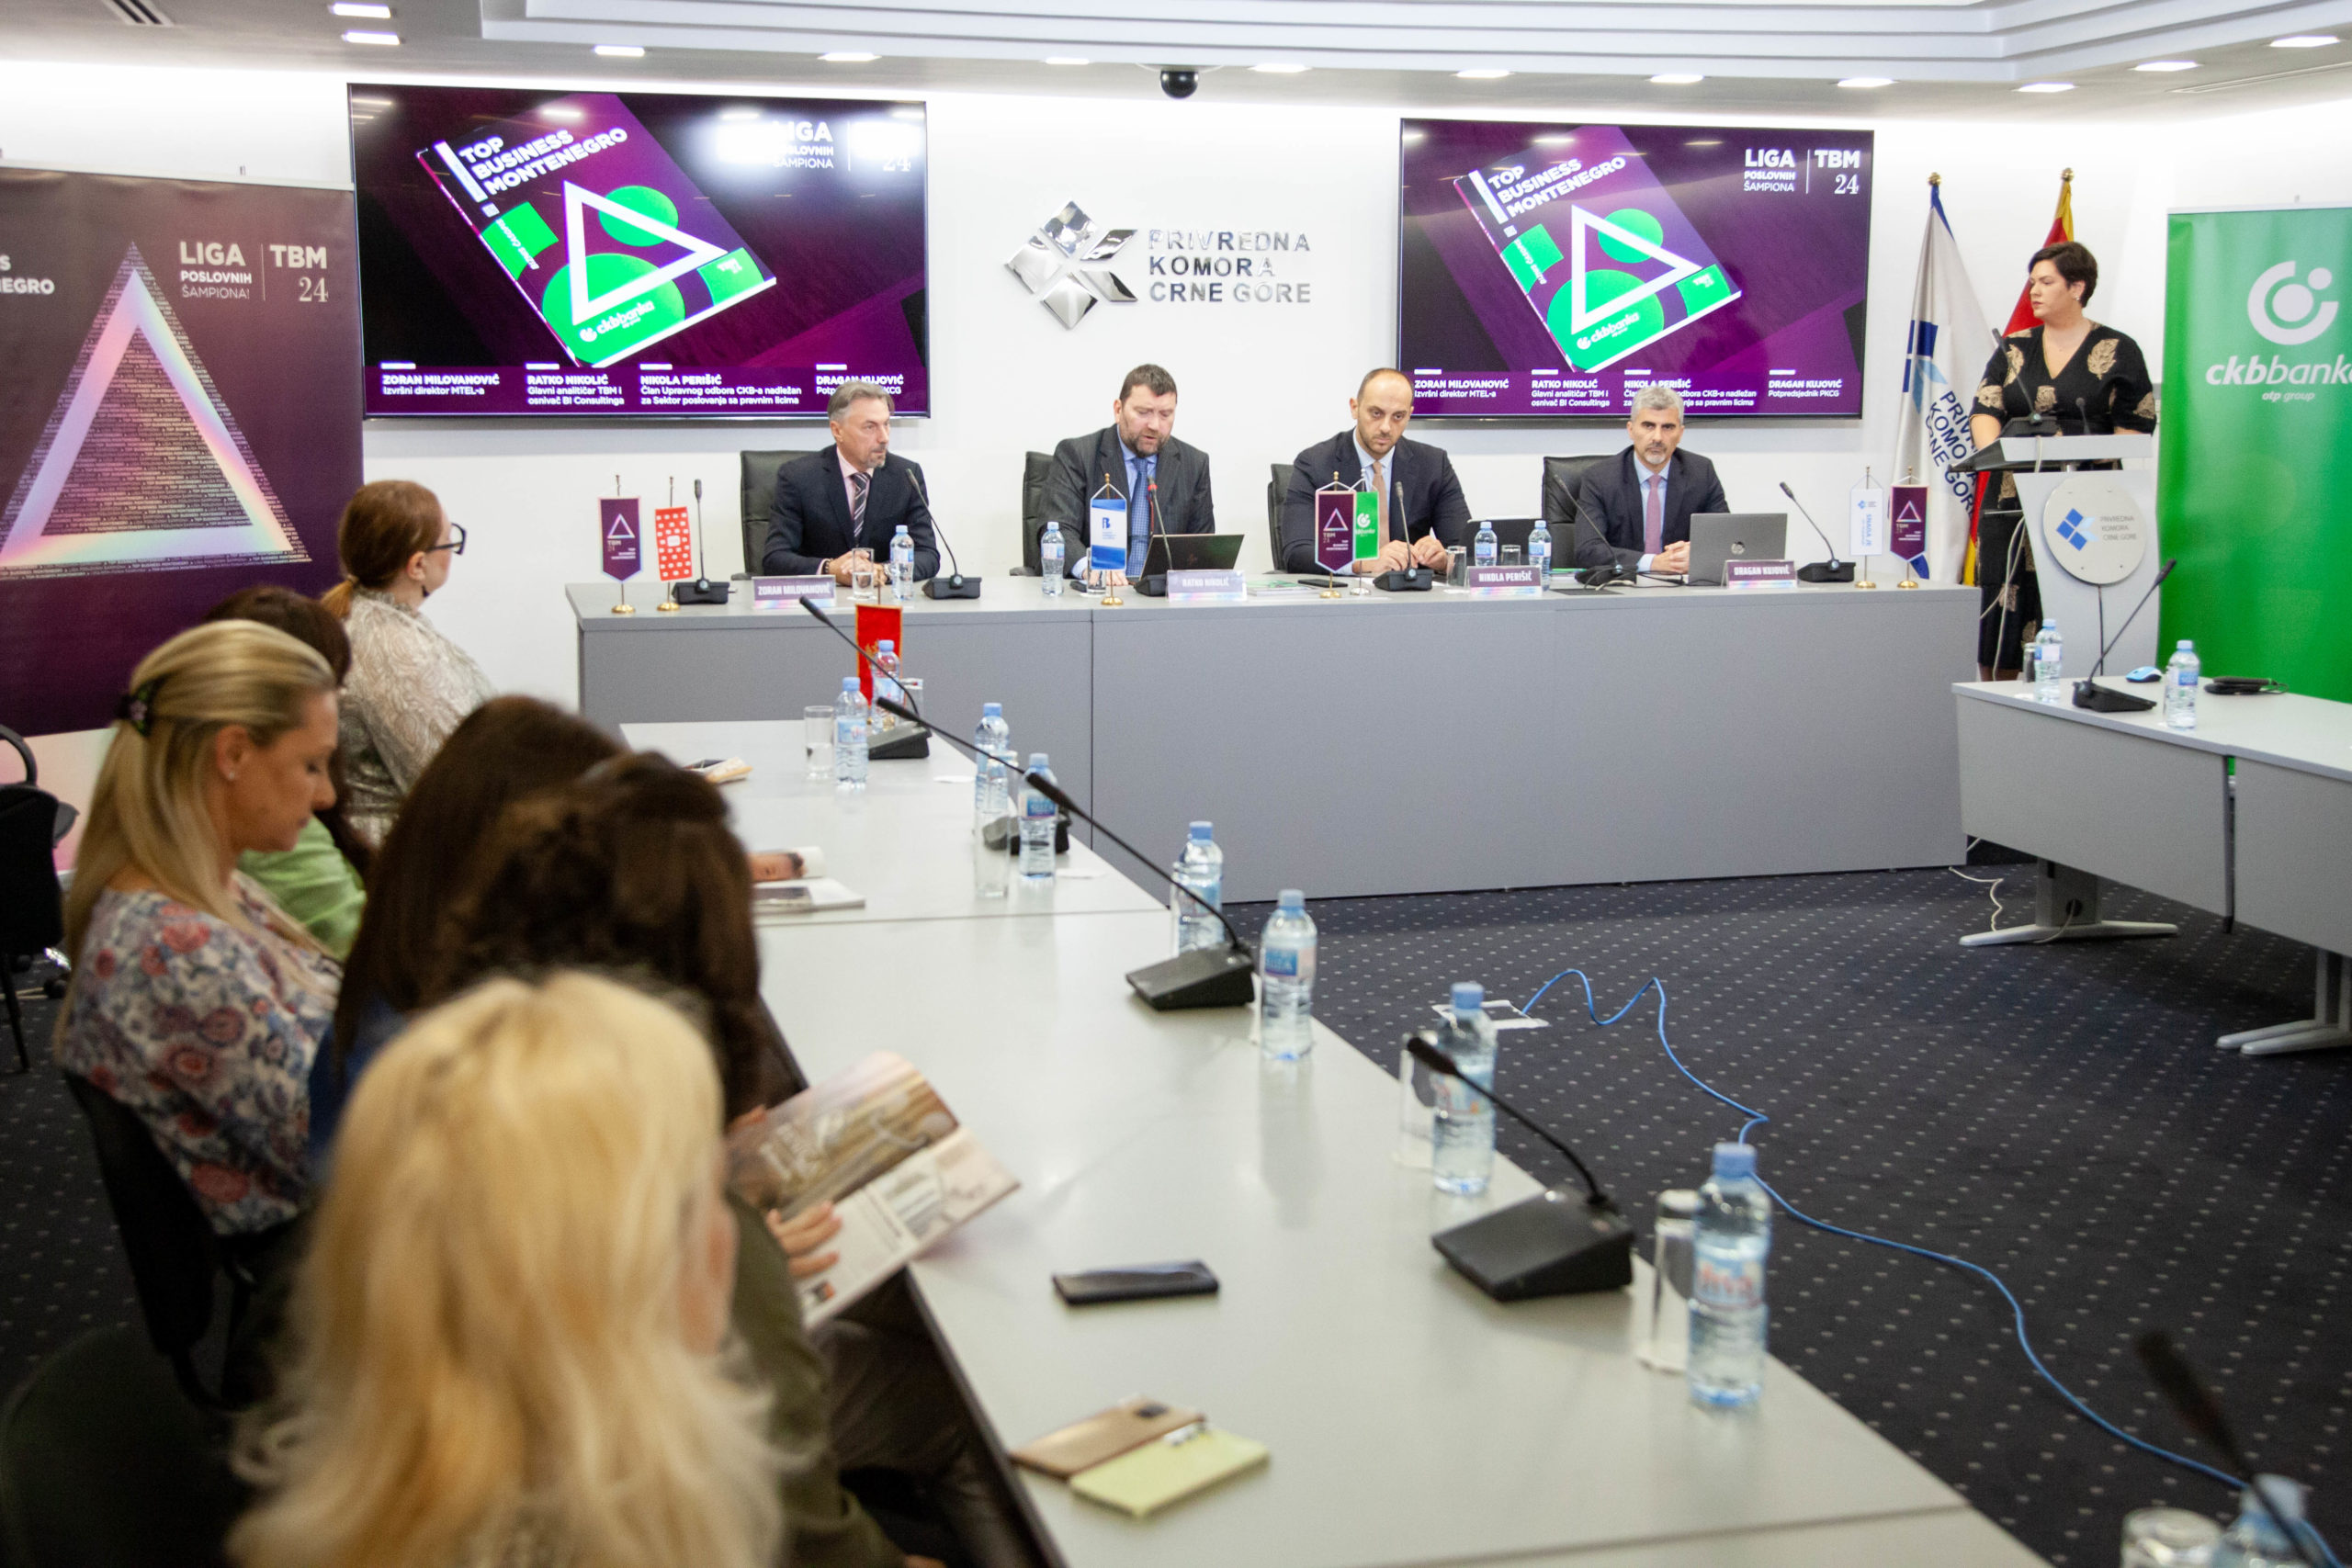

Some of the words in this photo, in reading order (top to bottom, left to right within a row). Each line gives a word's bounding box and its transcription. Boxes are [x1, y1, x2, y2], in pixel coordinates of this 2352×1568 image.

[772, 120, 833, 141] IGA
[458, 136, 504, 164] TOP
[471, 130, 574, 180] BUSINESS
[483, 128, 628, 196] MONTENEGRO
[1745, 149, 1796, 167] LIGA
[1815, 150, 1860, 169] TBM
[1487, 164, 1525, 189] TOP
[1497, 158, 1582, 204] BUSINESS
[1744, 171, 1796, 180] POSLOVNIH
[1506, 156, 1626, 218] MONTENEGRO
[1744, 180, 1794, 192] ŠAMPIONA
[1834, 174, 1860, 195] 24
[1148, 230, 1311, 252] PRIVREDNA
[180, 241, 246, 266] LIGA
[269, 243, 328, 269] TBM
[1148, 255, 1275, 276] KOMORA
[181, 270, 253, 284] POSLOVNIH
[0, 277, 55, 295] EGRO
[299, 276, 329, 302] 24
[1148, 282, 1223, 302] CRNE
[1233, 282, 1311, 303] GORE
[2206, 354, 2352, 386] ckbbank
[382, 375, 423, 385] ZORAN
[424, 374, 500, 385] MILOVANOVIĆ
[527, 375, 564, 385] RATKO
[565, 374, 608, 385] NIKOLIĆ
[640, 375, 681, 385] NIKOLA
[683, 374, 722, 385] PERIŠIĆ
[816, 376, 859, 385] DRAGAN
[1414, 379, 1446, 389] ZORAN
[1448, 378, 1510, 389] MILOVANOVIĆ
[1532, 379, 1561, 389] RATKO
[1563, 378, 1598, 389] NIKOLIĆ
[1624, 380, 1657, 389] NIKOLA
[1657, 378, 1691, 389] PERIŠIĆ
[1769, 380, 1804, 389] DRAGAN
[1806, 378, 1843, 389] KUJOVIĆ
[383, 386, 413, 395] Izvršni
[414, 386, 450, 395] direktor
[451, 387, 485, 395] MTEL-a
[527, 386, 555, 395] Glavni
[598, 386, 616, 395] TBM
[641, 386, 661, 395] Član
[662, 386, 702, 397] Upravnog
[705, 386, 735, 395] odbora
[736, 386, 763, 396] CKB-a
[881, 386, 902, 395] KCG
[1414, 389, 1439, 398] Izvršni
[1440, 389, 1468, 398] direktor
[1469, 389, 1497, 398] MTEL-a
[1532, 389, 1554, 398] Glavni
[1623, 389, 1638, 398] Čla
[1702, 389, 1724, 398] CKB-a
[1769, 389, 1819, 399] Potpredsjednik
[2262, 390, 2281, 402] otp
[2283, 391, 2315, 402] group
[527, 395, 561, 405] osnivač
[573, 396, 625, 406] Consultinga
[653, 397, 681, 405] Sektor
[683, 397, 728, 407] poslovanja
[740, 397, 774, 407] pravnim
[775, 397, 799, 405] licima
[1532, 399, 1558, 407] osnivač
[1568, 399, 1610, 408] Consultinga
[1704, 399, 1732, 408] pravnim
[1930, 402, 1978, 486] KOMOA
[1478, 572, 1504, 582] NIKOLA
[1505, 570, 1532, 581] PERIŠIĆ
[1734, 566, 1761, 576] DRAGAN
[758, 585, 782, 595] ZORAN
